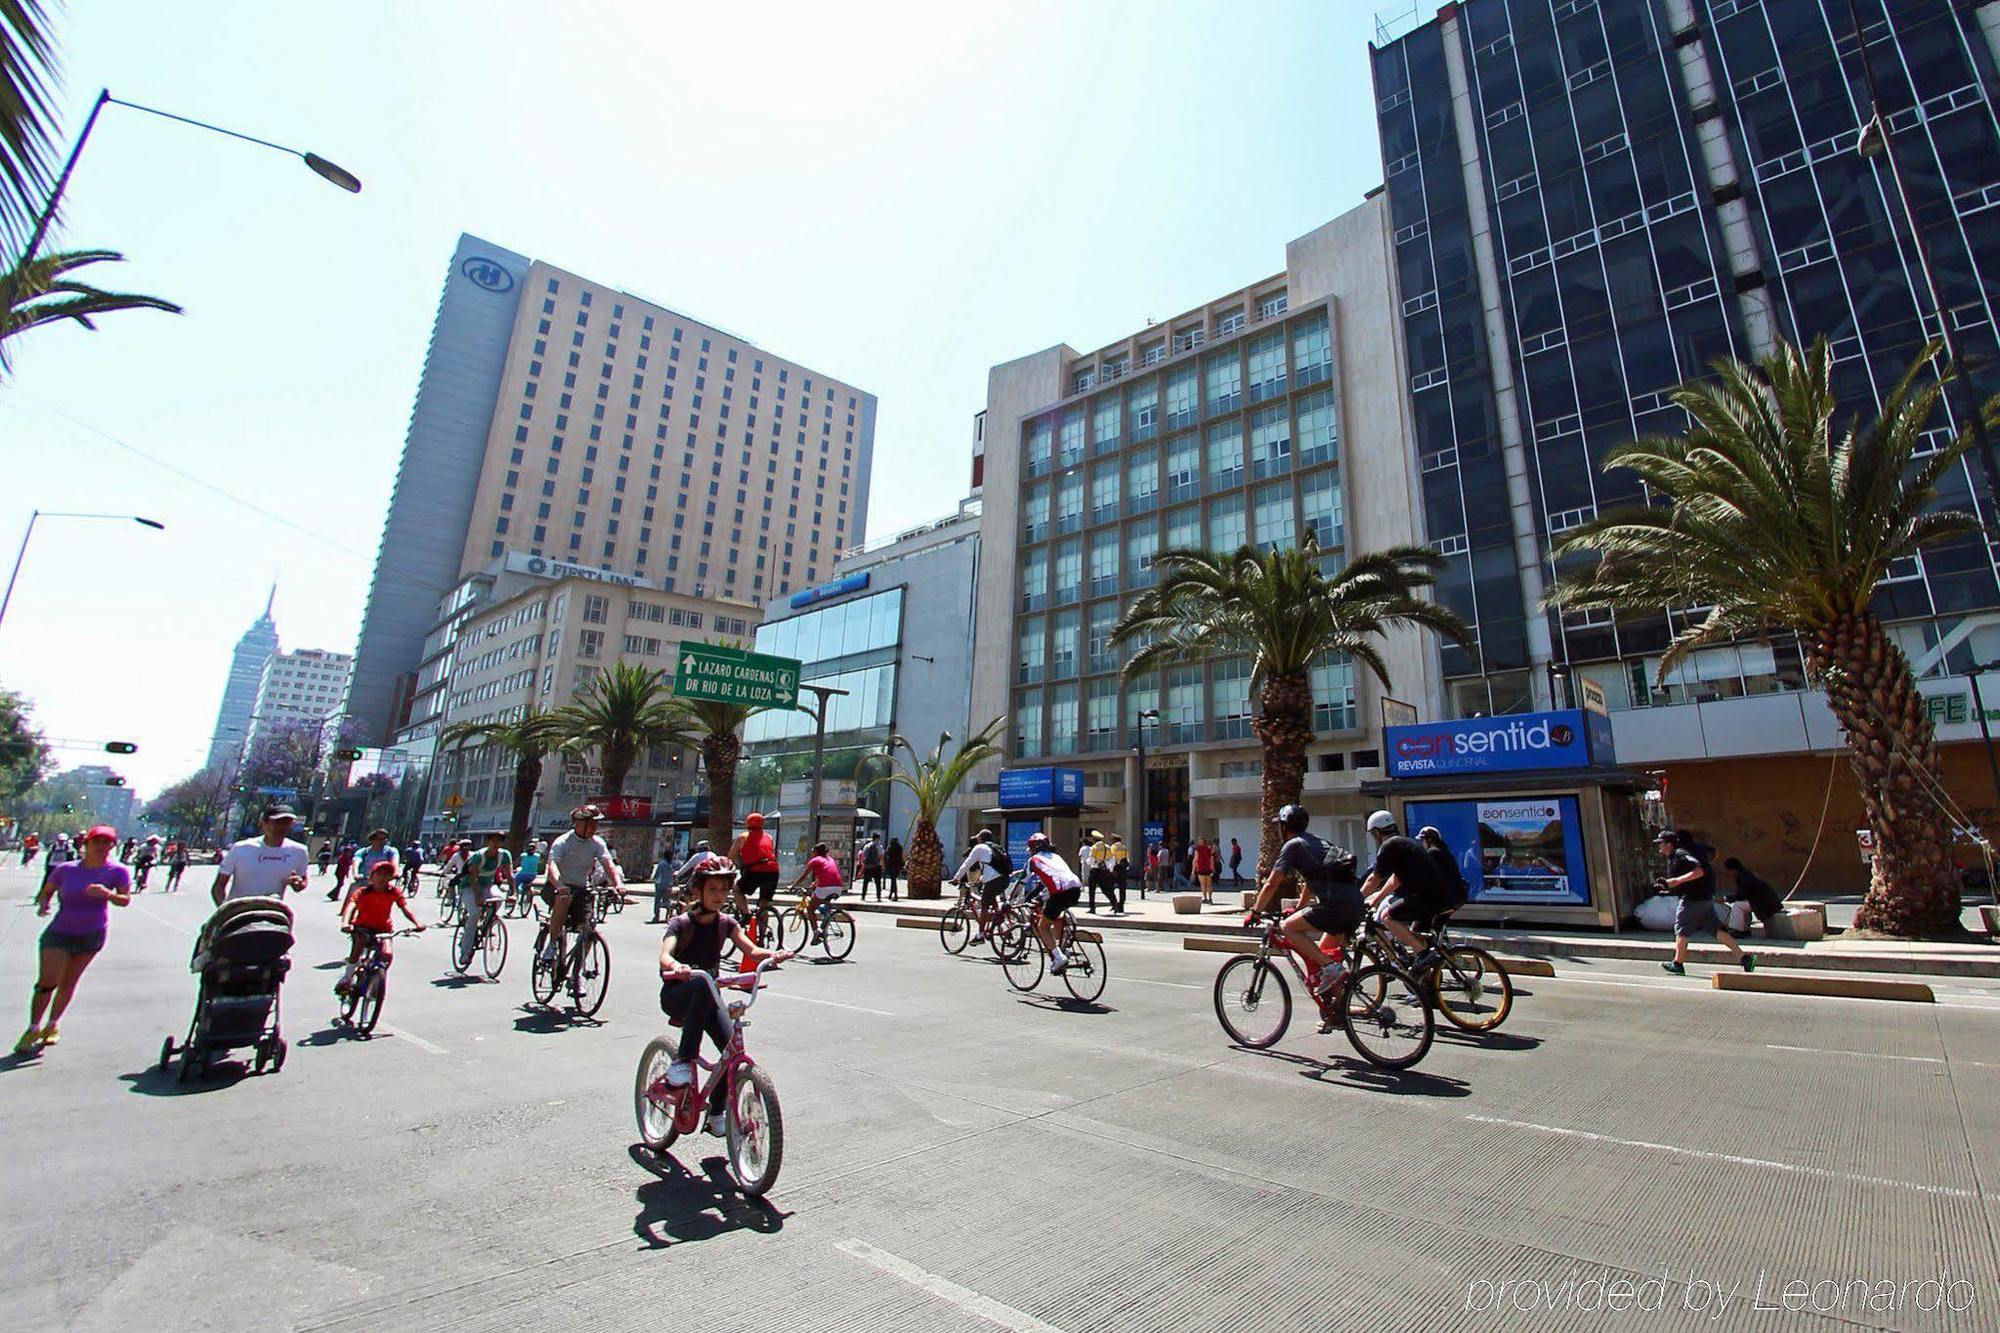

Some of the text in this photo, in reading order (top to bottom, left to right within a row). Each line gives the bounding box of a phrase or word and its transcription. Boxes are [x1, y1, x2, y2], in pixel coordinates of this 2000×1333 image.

[552, 563, 603, 581] FIESTA
[698, 661, 775, 684] LAZARO CARDENAS
[685, 678, 773, 700] DR RIO DE LA LOZA
[1397, 757, 1489, 772] REVISTA QUINCENAL
[1143, 827, 1164, 836] one
